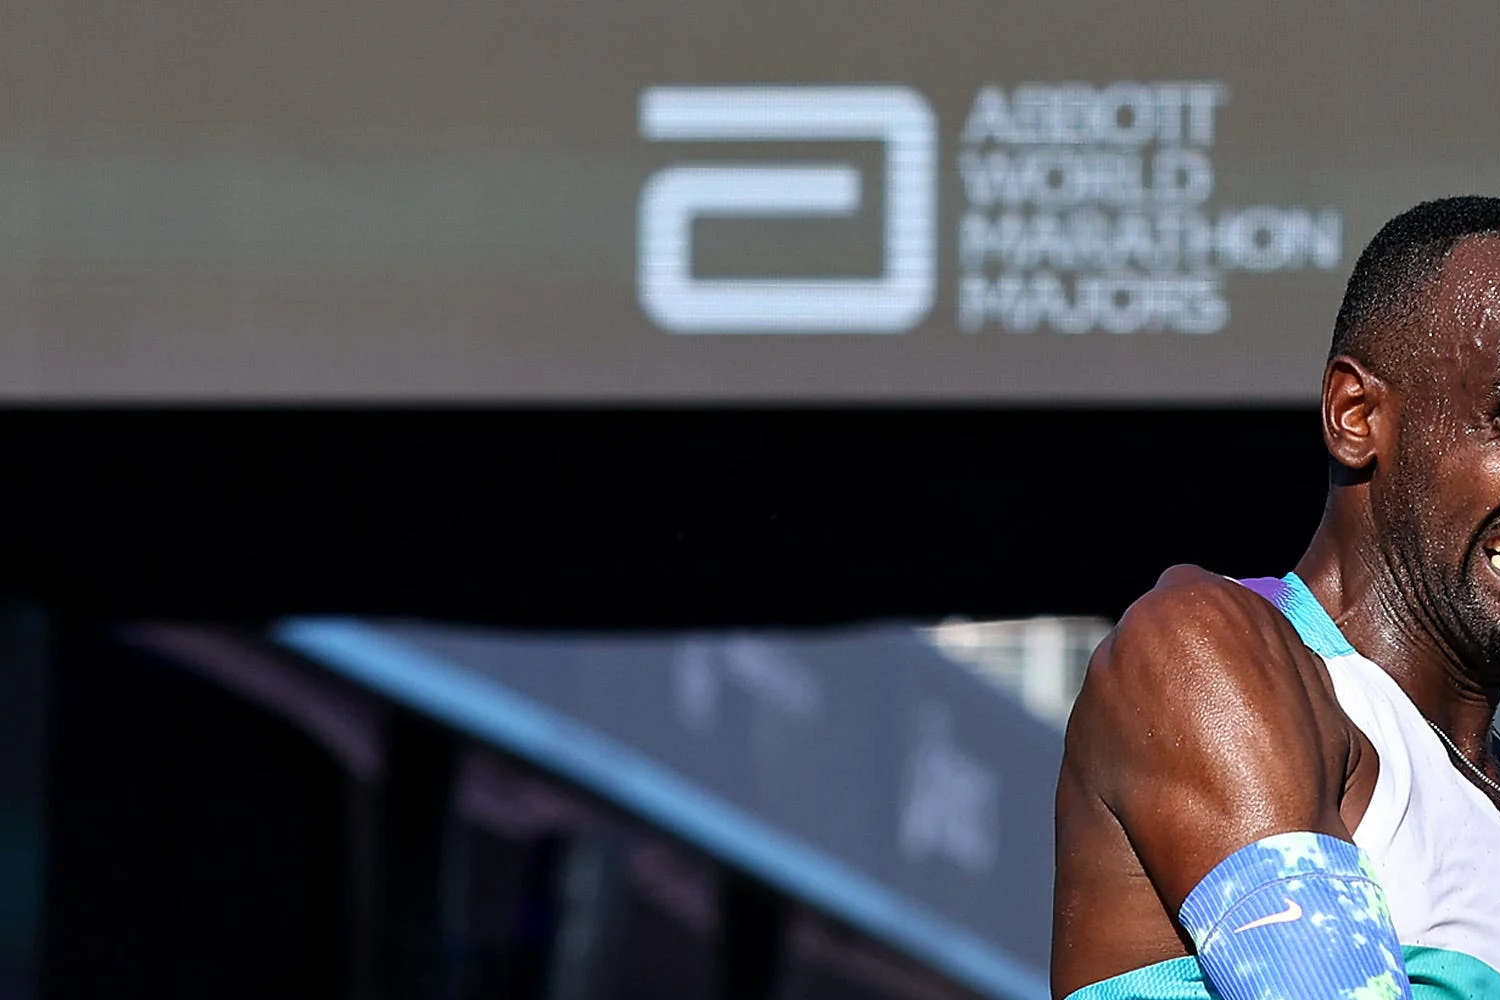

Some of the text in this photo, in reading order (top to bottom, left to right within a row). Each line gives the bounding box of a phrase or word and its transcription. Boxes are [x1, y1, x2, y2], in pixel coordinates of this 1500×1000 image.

[960, 147, 1214, 204] WORLD
[959, 206, 1343, 271] MARATHON
[958, 272, 1230, 335] MAJORS
